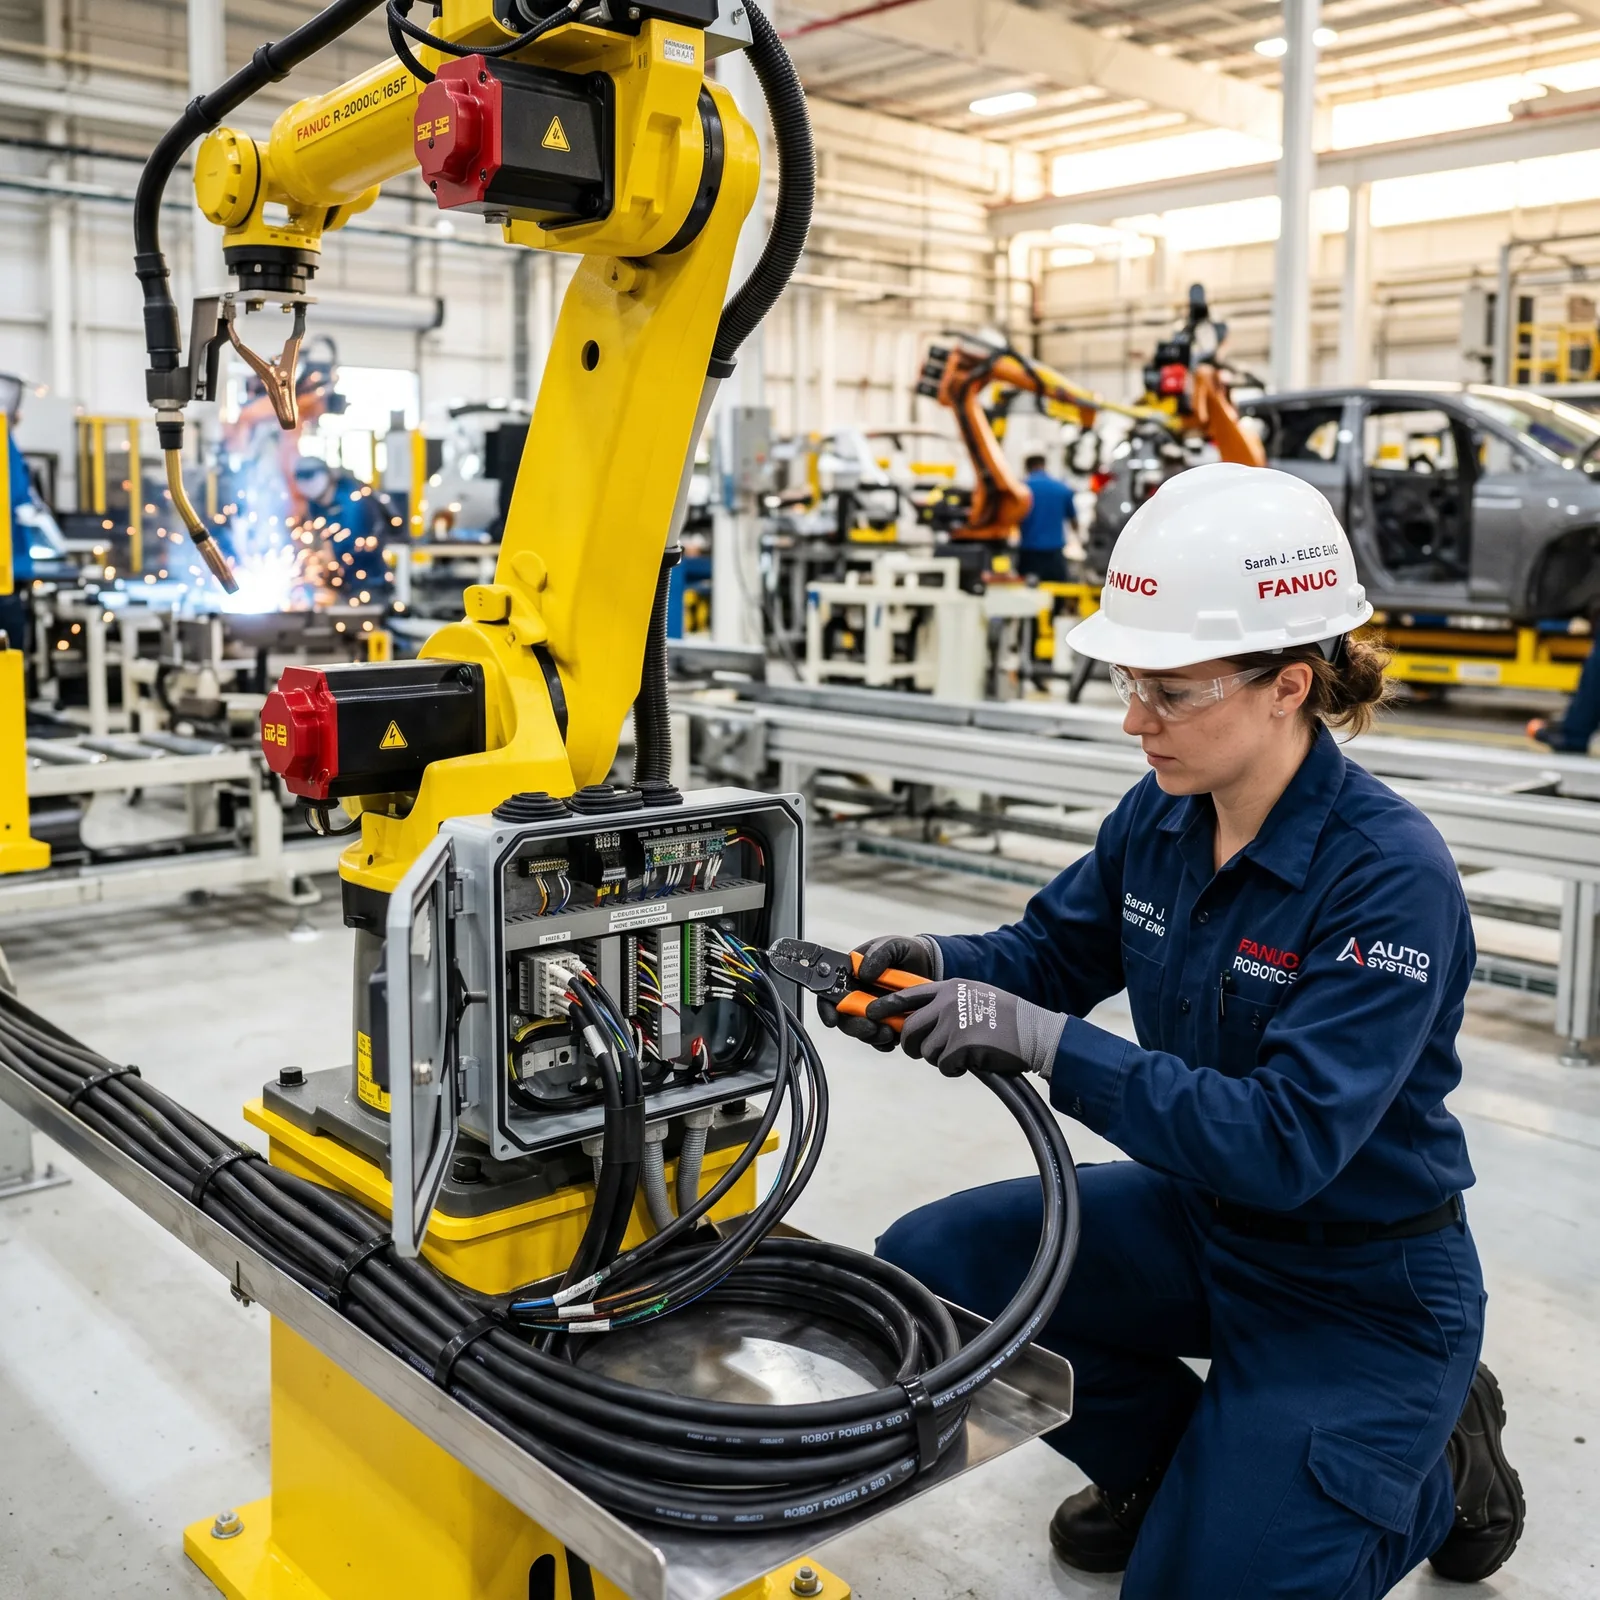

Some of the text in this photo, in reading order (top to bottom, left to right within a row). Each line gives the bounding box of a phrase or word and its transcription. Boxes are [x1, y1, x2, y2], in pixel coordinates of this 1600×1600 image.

[297, 75, 407, 142] FANUC R-2000iC/165F
[1244, 555, 1277, 570] Sarah
[1280, 553, 1289, 564] J.
[1297, 547, 1321, 561] ELEC
[1322, 544, 1339, 556] ENG
[1257, 569, 1338, 599] FANUC
[1124, 892, 1165, 922] Sarah J.
[1145, 920, 1166, 937] ENG
[1237, 937, 1300, 969] FANUC
[1367, 940, 1430, 969] AUTO
[1233, 956, 1298, 985] ROBOTICS
[1366, 957, 1428, 983] SYSTEMS
[801, 1431, 835, 1444] ROBOT
[838, 1423, 873, 1439] POWER
[875, 1421, 883, 1430] &
[784, 1503, 820, 1519] ROBOT
[823, 1490, 858, 1509] POWER
[861, 1486, 868, 1495] &
